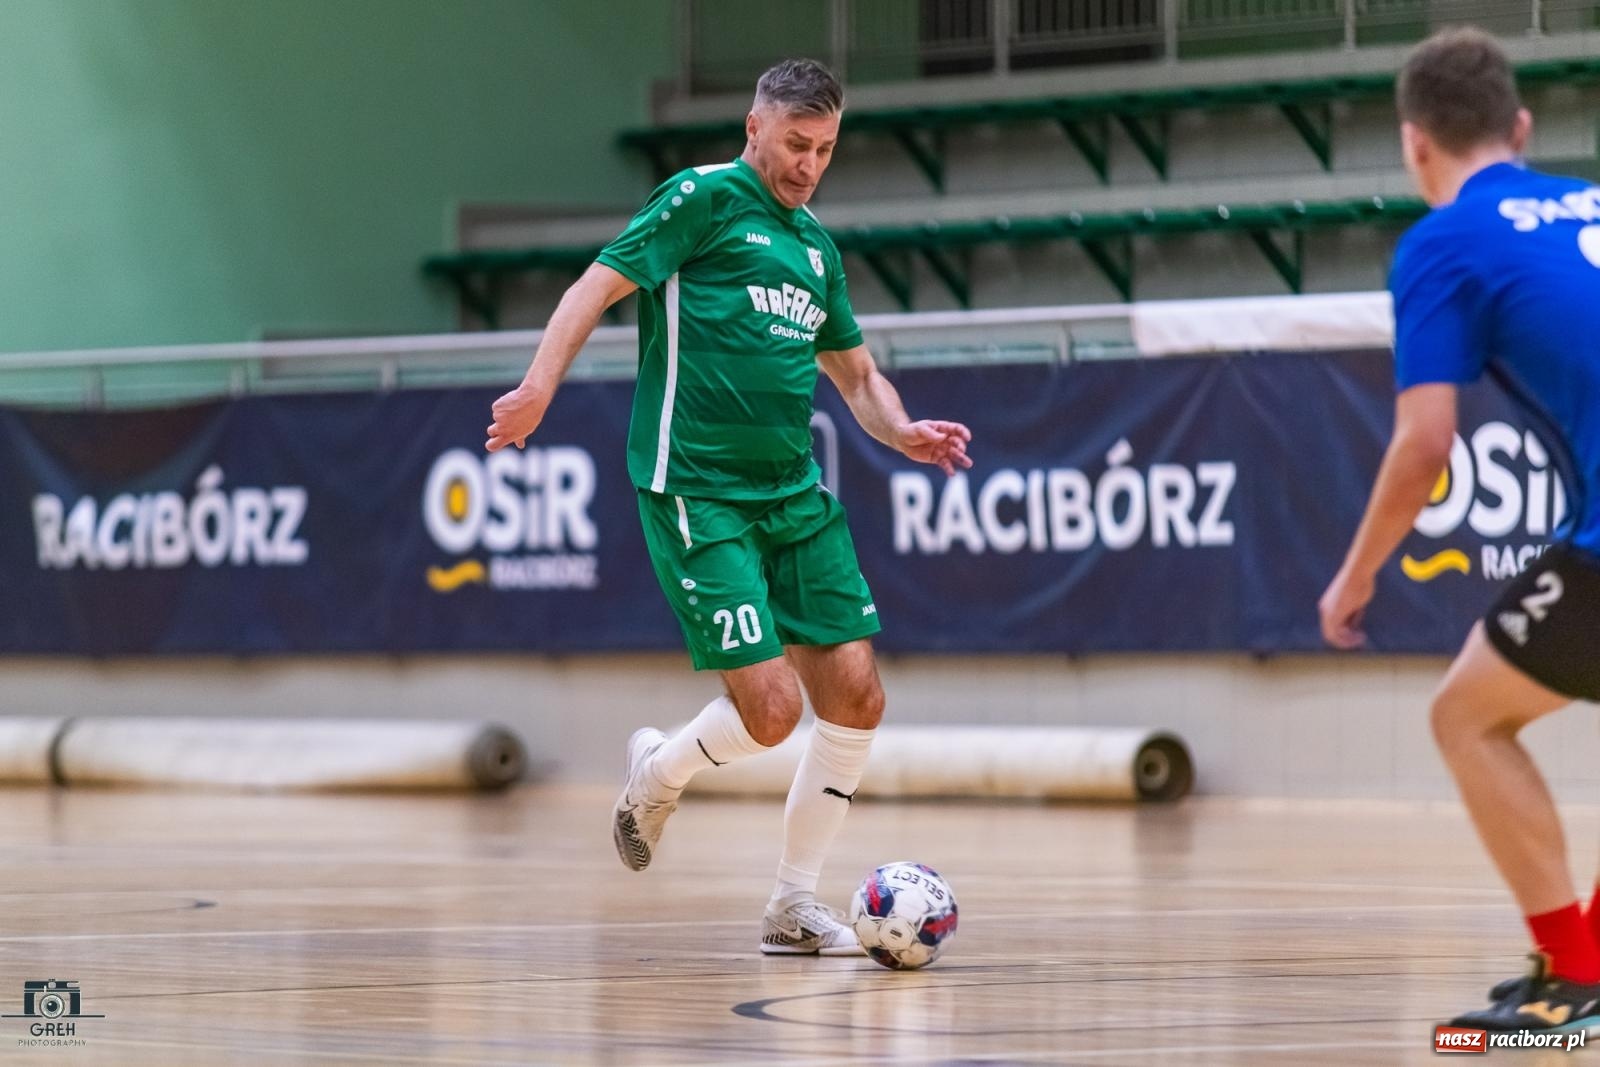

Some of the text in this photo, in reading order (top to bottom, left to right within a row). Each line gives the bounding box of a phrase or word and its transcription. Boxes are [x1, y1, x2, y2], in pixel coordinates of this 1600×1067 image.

[746, 232, 771, 246] JAKO
[769, 324, 801, 341] GRUPA
[32, 463, 308, 569] RACIBÓRZ
[891, 437, 1236, 555] RACIBÓRZ
[1520, 570, 1564, 622] 2
[713, 603, 763, 651] 20
[892, 870, 945, 900] SELECT
